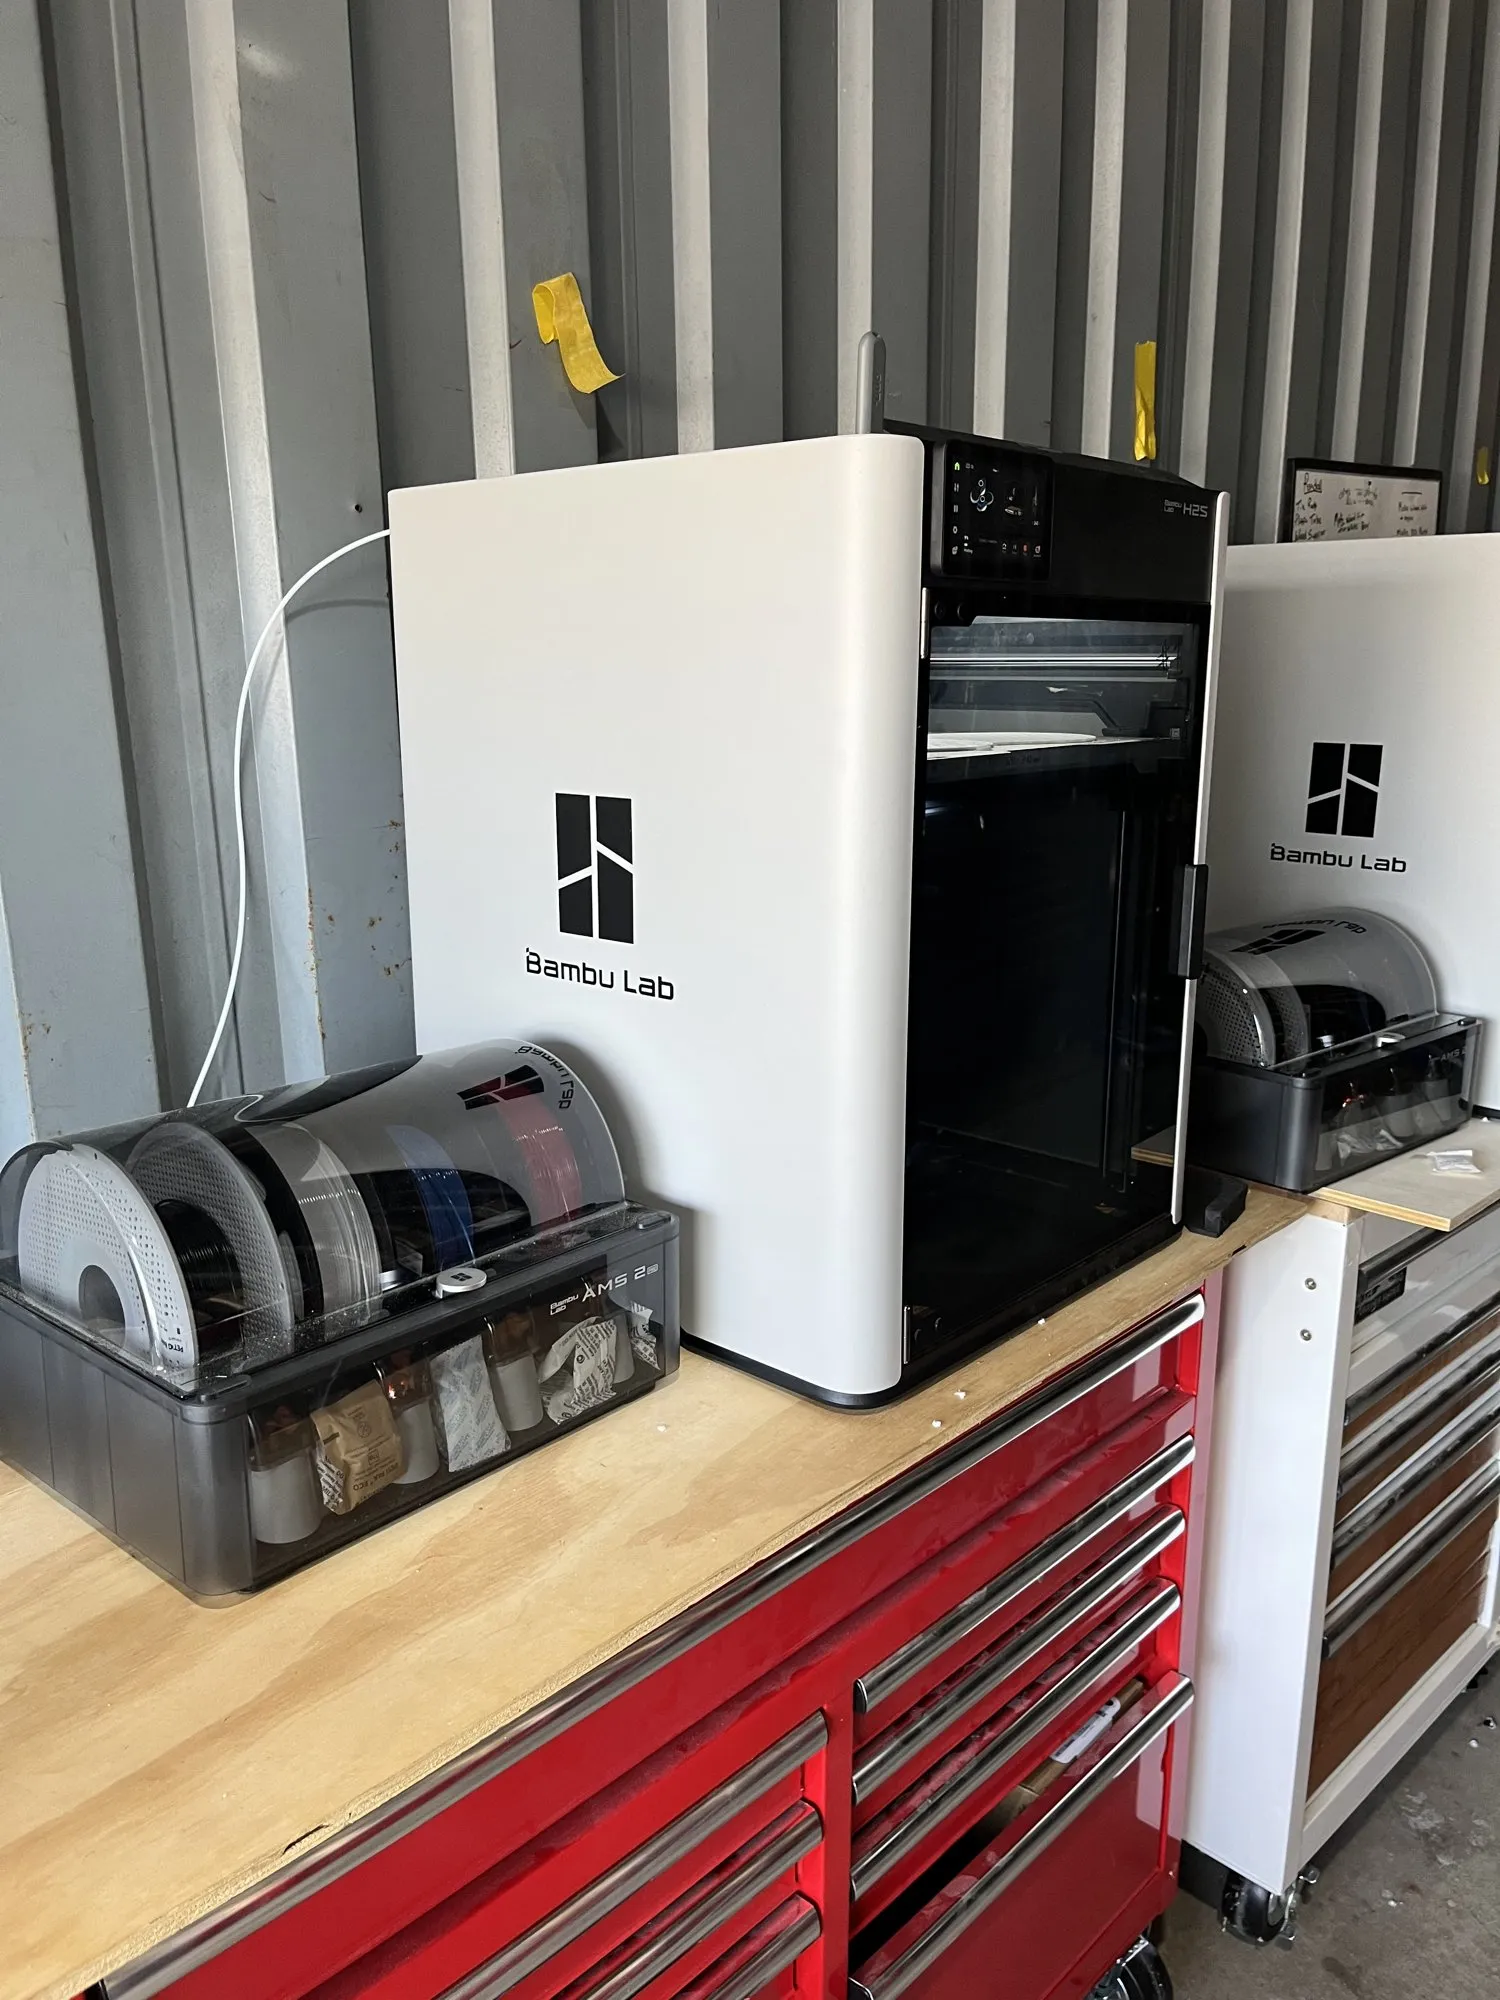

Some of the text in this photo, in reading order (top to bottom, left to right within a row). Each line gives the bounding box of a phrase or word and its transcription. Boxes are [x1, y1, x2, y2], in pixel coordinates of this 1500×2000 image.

[1183, 502, 1208, 518] H2S
[1270, 843, 1407, 873] Bambu Lab
[525, 947, 674, 1001] Bambu Lab
[514, 1045, 575, 1109] Bambu Lab
[581, 1273, 628, 1302] AMS
[634, 1265, 646, 1280] 2
[550, 1294, 579, 1310] Bambu
[550, 1305, 567, 1316] Lab
